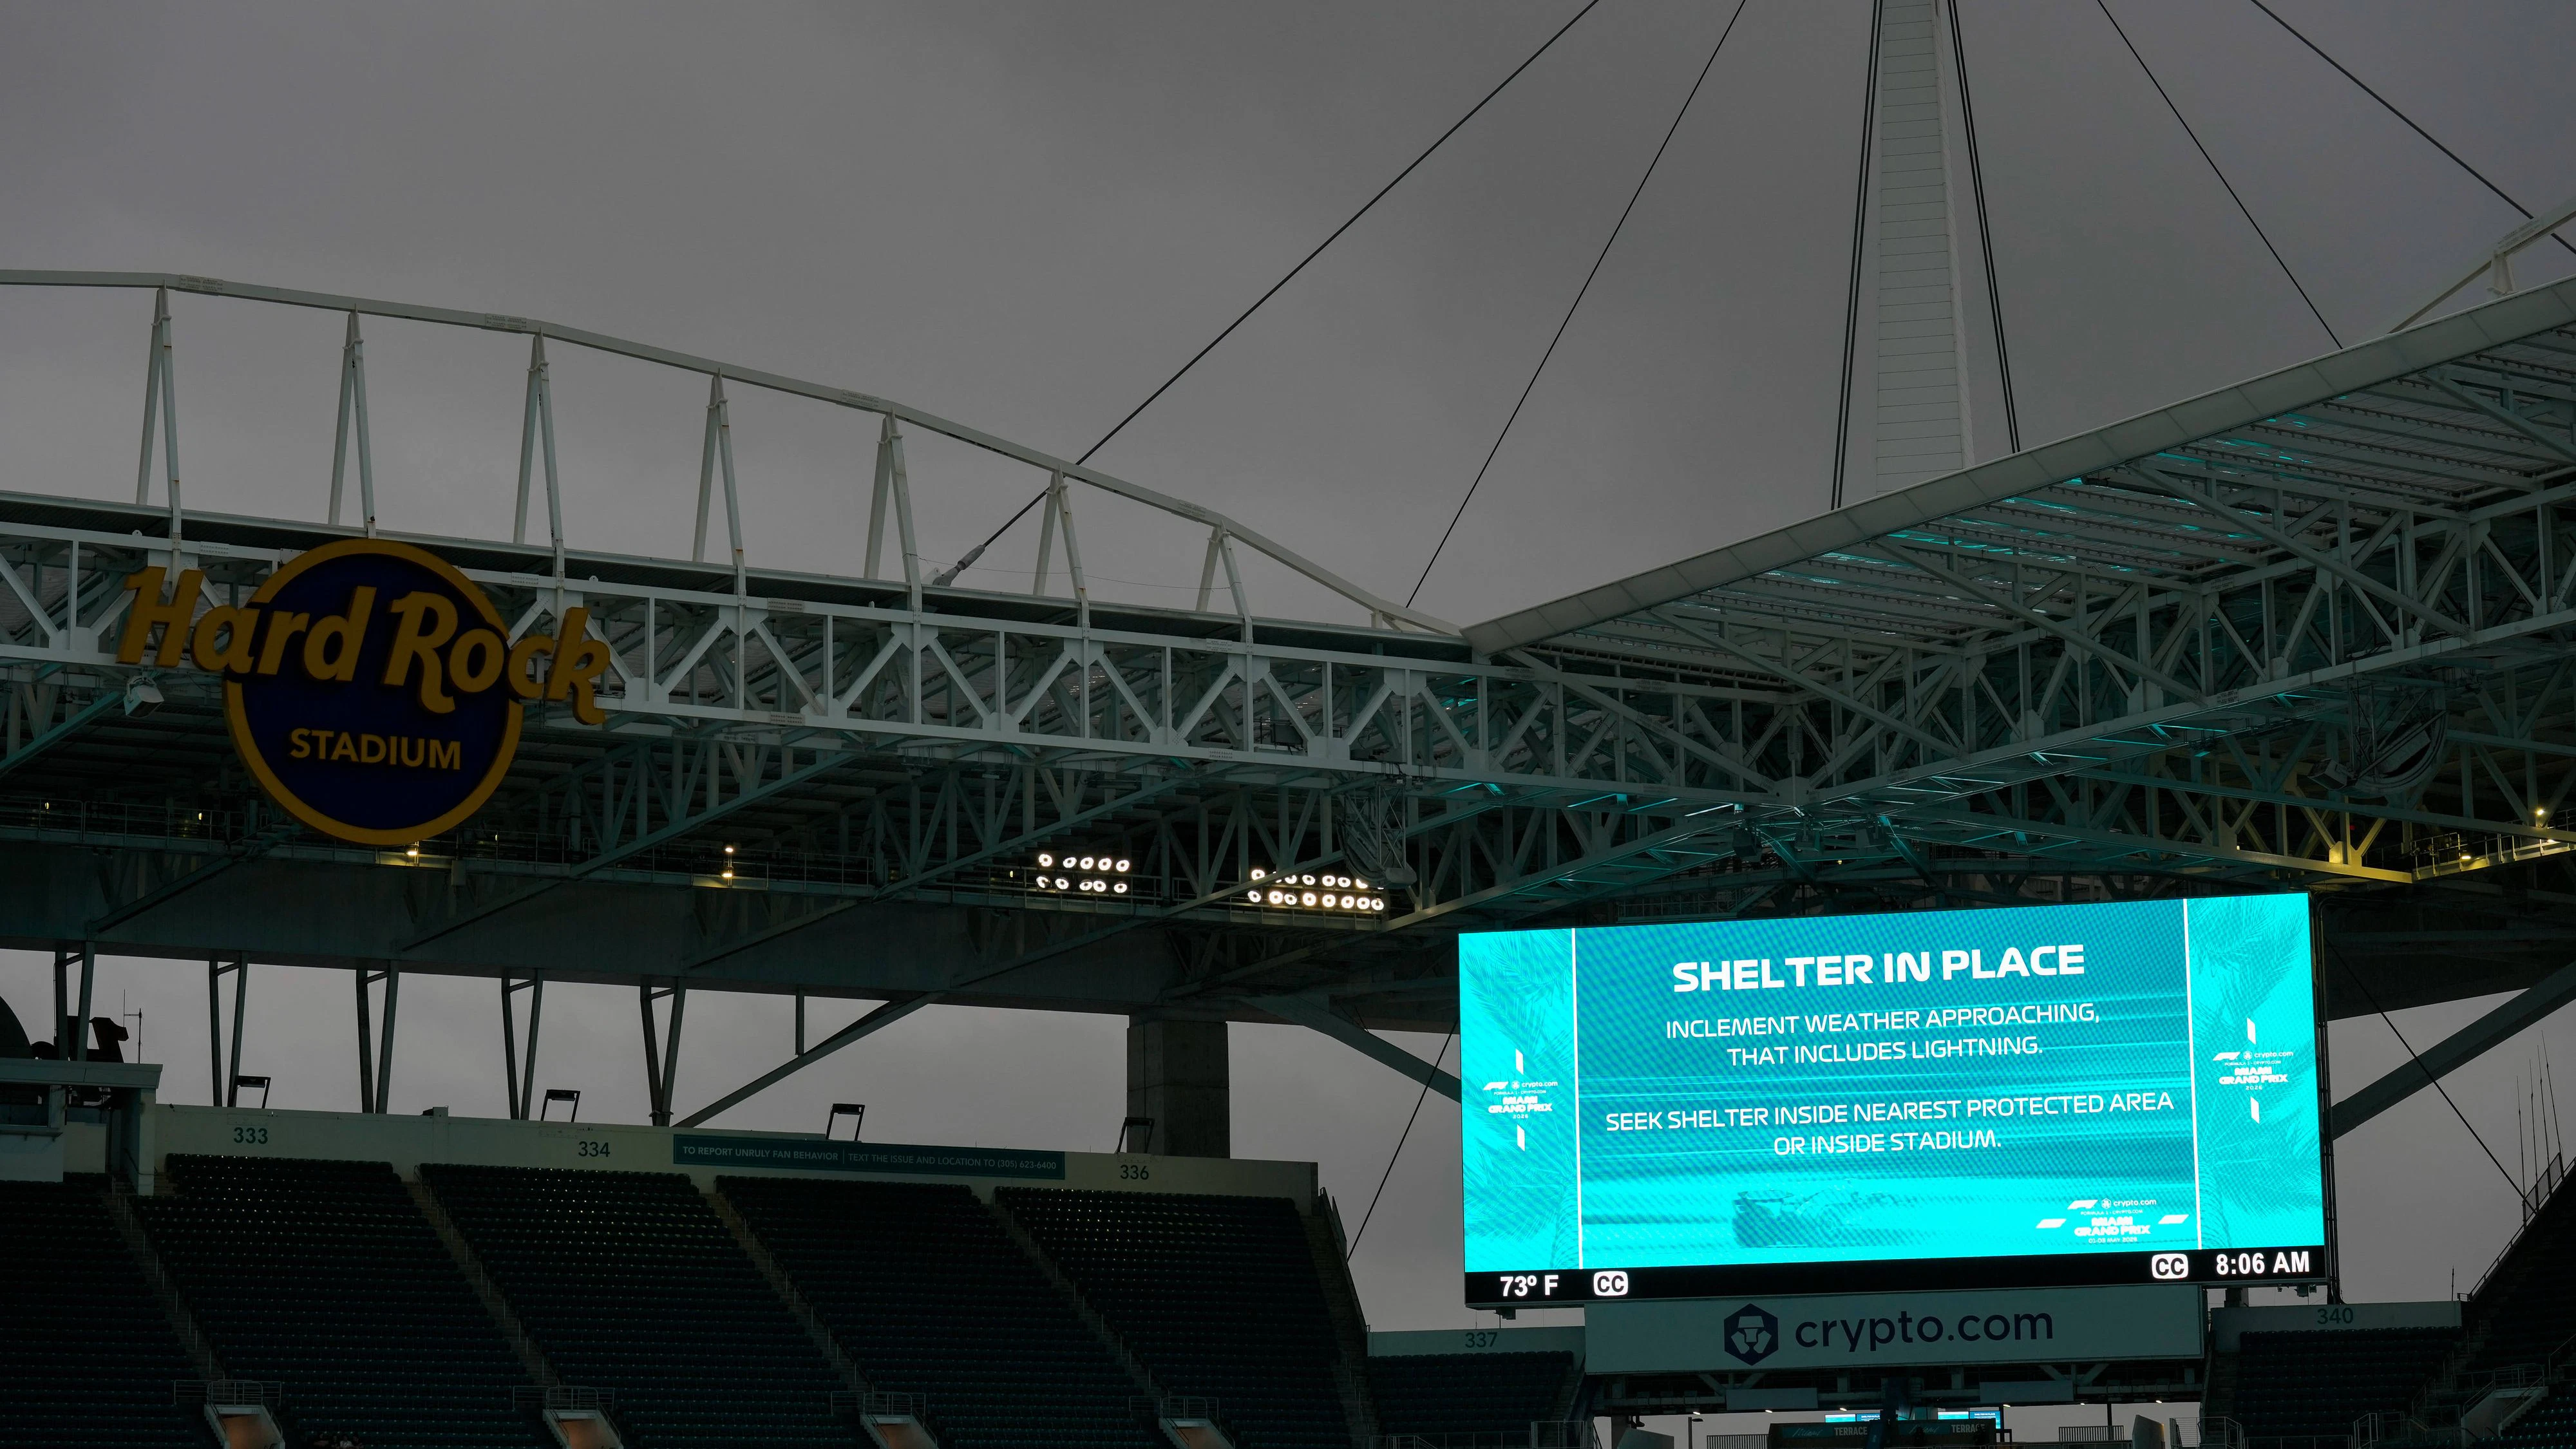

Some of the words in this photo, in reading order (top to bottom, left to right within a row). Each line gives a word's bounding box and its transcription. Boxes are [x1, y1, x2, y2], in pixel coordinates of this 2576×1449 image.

[117, 567, 377, 681] Hard
[383, 591, 611, 725] Rock
[290, 728, 461, 770] STADIUM
[1673, 954, 1873, 992] SHELTER
[1884, 952, 1930, 982] IN
[1942, 944, 2084, 980] PLACE
[1667, 1016, 1800, 1039] INCLEMENT
[1805, 1010, 1920, 1033] WEATHER
[1926, 1003, 2100, 1028] APPROACHING,
[1727, 1047, 1788, 1066] THAT
[1795, 1041, 1906, 1063] INCLUDES
[1913, 1036, 2043, 1059] LIGHTNING.
[2219, 1075, 2260, 1084] GRAND
[2260, 1074, 2289, 1083] PRIX
[2234, 1066, 2272, 1075] MIAMI
[1488, 1104, 1526, 1113] GRAND
[1528, 1103, 1553, 1112] PRIX
[1502, 1096, 1538, 1104] MIAMI
[1607, 1112, 1662, 1131] SEEK
[1668, 1108, 1768, 1129] SHELTER
[1776, 1105, 1847, 1124] INSIDE
[1855, 1101, 1961, 1121] NEAREST
[1967, 1095, 2103, 1117] PROTECTED
[2110, 1092, 2174, 1112] AREA
[233, 1127, 268, 1144] 333
[1775, 1137, 1805, 1155] OR
[1812, 1133, 1884, 1153] INSIDE
[1891, 1130, 2002, 1151] STADIUM.
[578, 1141, 611, 1158] 334
[682, 1146, 696, 1154] TO
[698, 1146, 733, 1156] REPORT
[735, 1148, 770, 1158] UNRULY
[773, 1150, 791, 1159] FAN
[793, 1151, 838, 1160] BEHAVIOR
[848, 1153, 868, 1162] TEXT
[871, 1154, 888, 1162] THE
[891, 1155, 913, 1164] ISSUE
[916, 1156, 935, 1164] AND
[938, 1157, 981, 1166] LOCATION
[984, 1159, 995, 1167] TO
[998, 1159, 1018, 1169] (305)
[1019, 1160, 1057, 1170] 623-6400
[1120, 1164, 1150, 1180] 336
[2113, 1198, 2157, 1207] crypto.com
[2091, 1216, 2133, 1226] MIAMI
[2074, 1226, 2119, 1236] GRAND
[2121, 1225, 2151, 1235] PRIX
[2155, 1258, 2184, 1276] CC
[2216, 1253, 2265, 1275] 8:06
[2273, 1251, 2309, 1273] AM
[1545, 1274, 1558, 1296] F
[1597, 1275, 1625, 1293] CC
[2316, 1307, 2354, 1324] 340
[1465, 1332, 1497, 1348] 337
[1795, 1311, 2053, 1352] crypto.com
[1834, 1426, 1868, 1436] TERRACE
